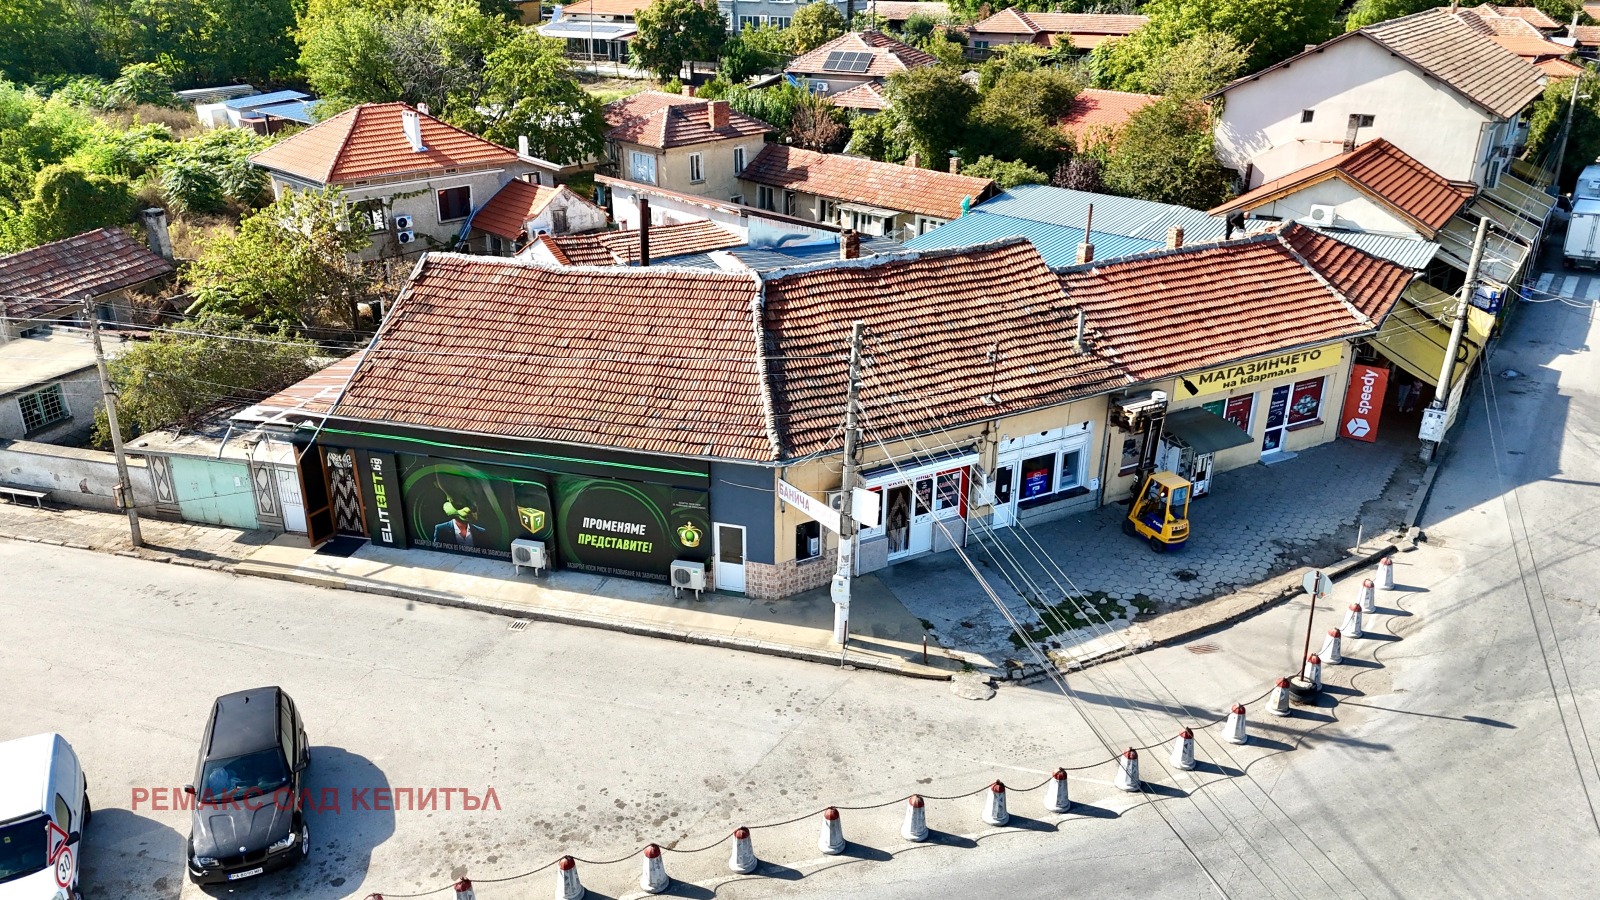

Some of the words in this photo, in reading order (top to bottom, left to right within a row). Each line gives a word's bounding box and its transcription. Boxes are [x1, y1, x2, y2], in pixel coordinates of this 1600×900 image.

[1199, 349, 1322, 386] МАГАЗИНЧЕТО
[1223, 380, 1237, 389] на
[1240, 366, 1297, 386] квартала
[1358, 369, 1379, 415] speedy
[582, 517, 647, 536] ПРОМЕНЯМЕ
[577, 533, 653, 553] ПРЕДСТАВИТЕ!
[60, 854, 71, 880] 30
